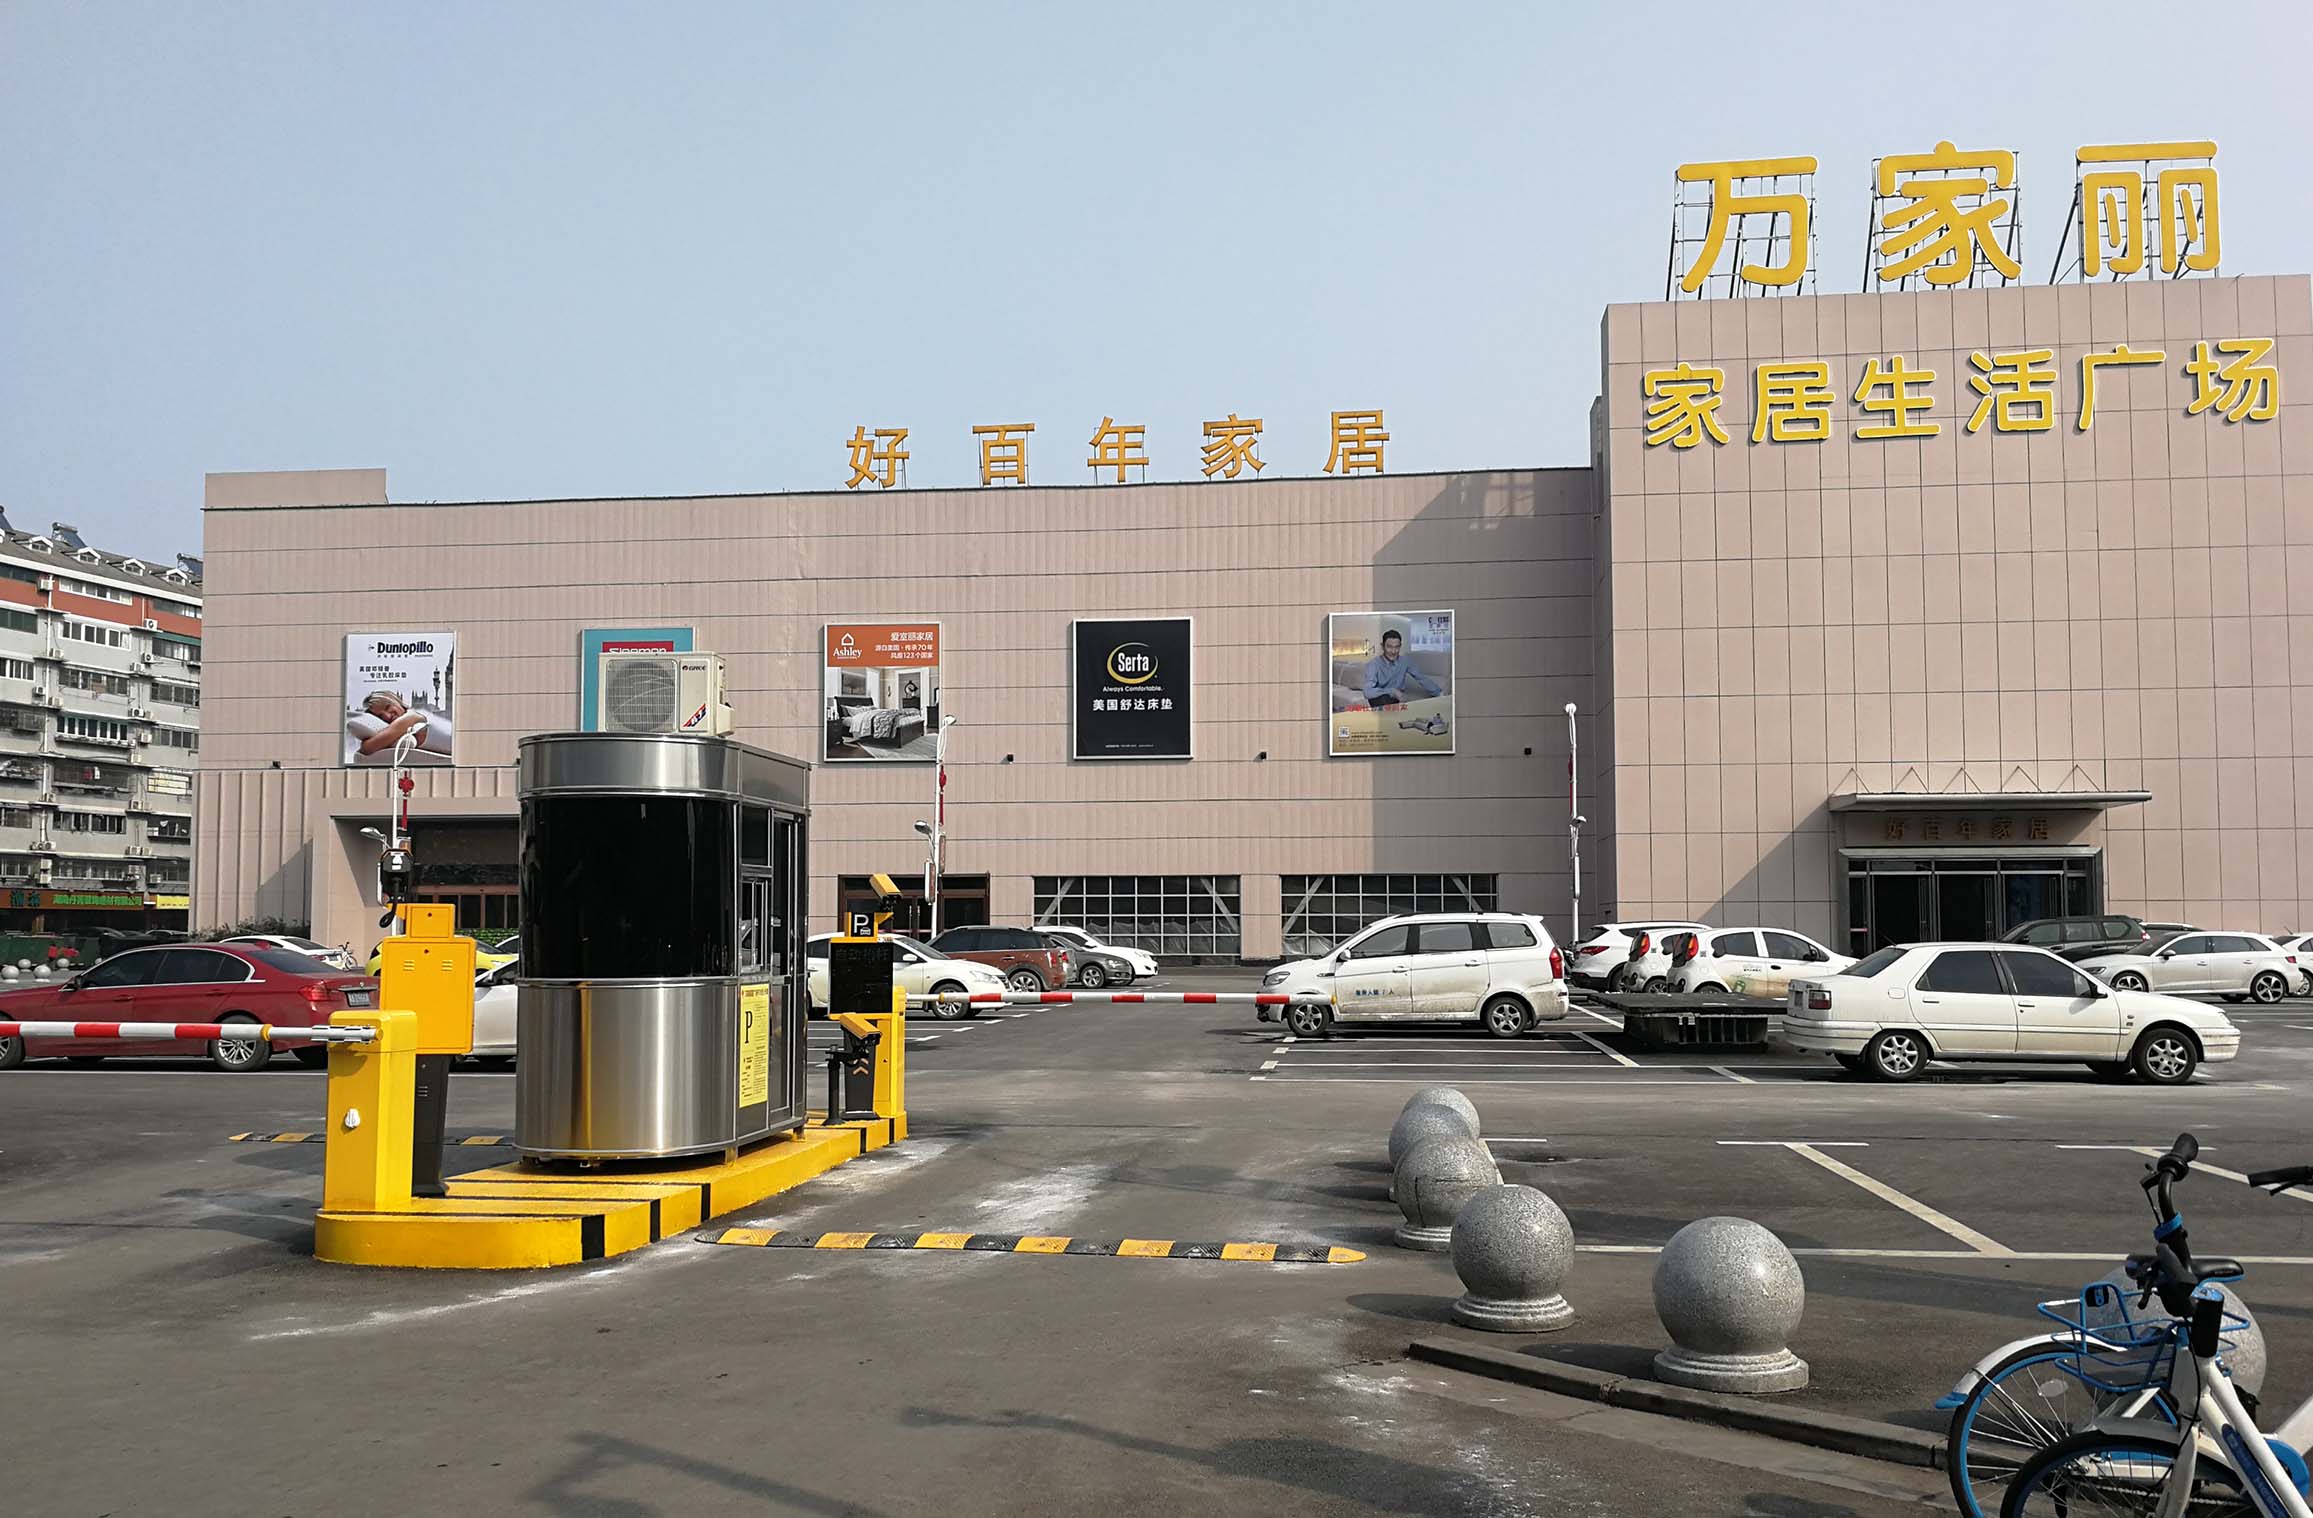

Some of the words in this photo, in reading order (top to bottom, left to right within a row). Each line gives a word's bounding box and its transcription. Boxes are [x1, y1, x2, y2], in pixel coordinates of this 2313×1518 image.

[1677, 140, 2221, 293] 万家丽
[1644, 338, 2280, 449] 家居生活广场
[845, 410, 1390, 490] 好百年家居
[377, 641, 434, 655] Dunlopillo
[833, 647, 863, 657] Ashley
[1118, 652, 1149, 672] Serta
[1092, 698, 1173, 711] 美国舒达床垫
[1886, 816, 2049, 840] 好百年家居
[853, 914, 869, 934] P
[745, 1010, 753, 1044] P
